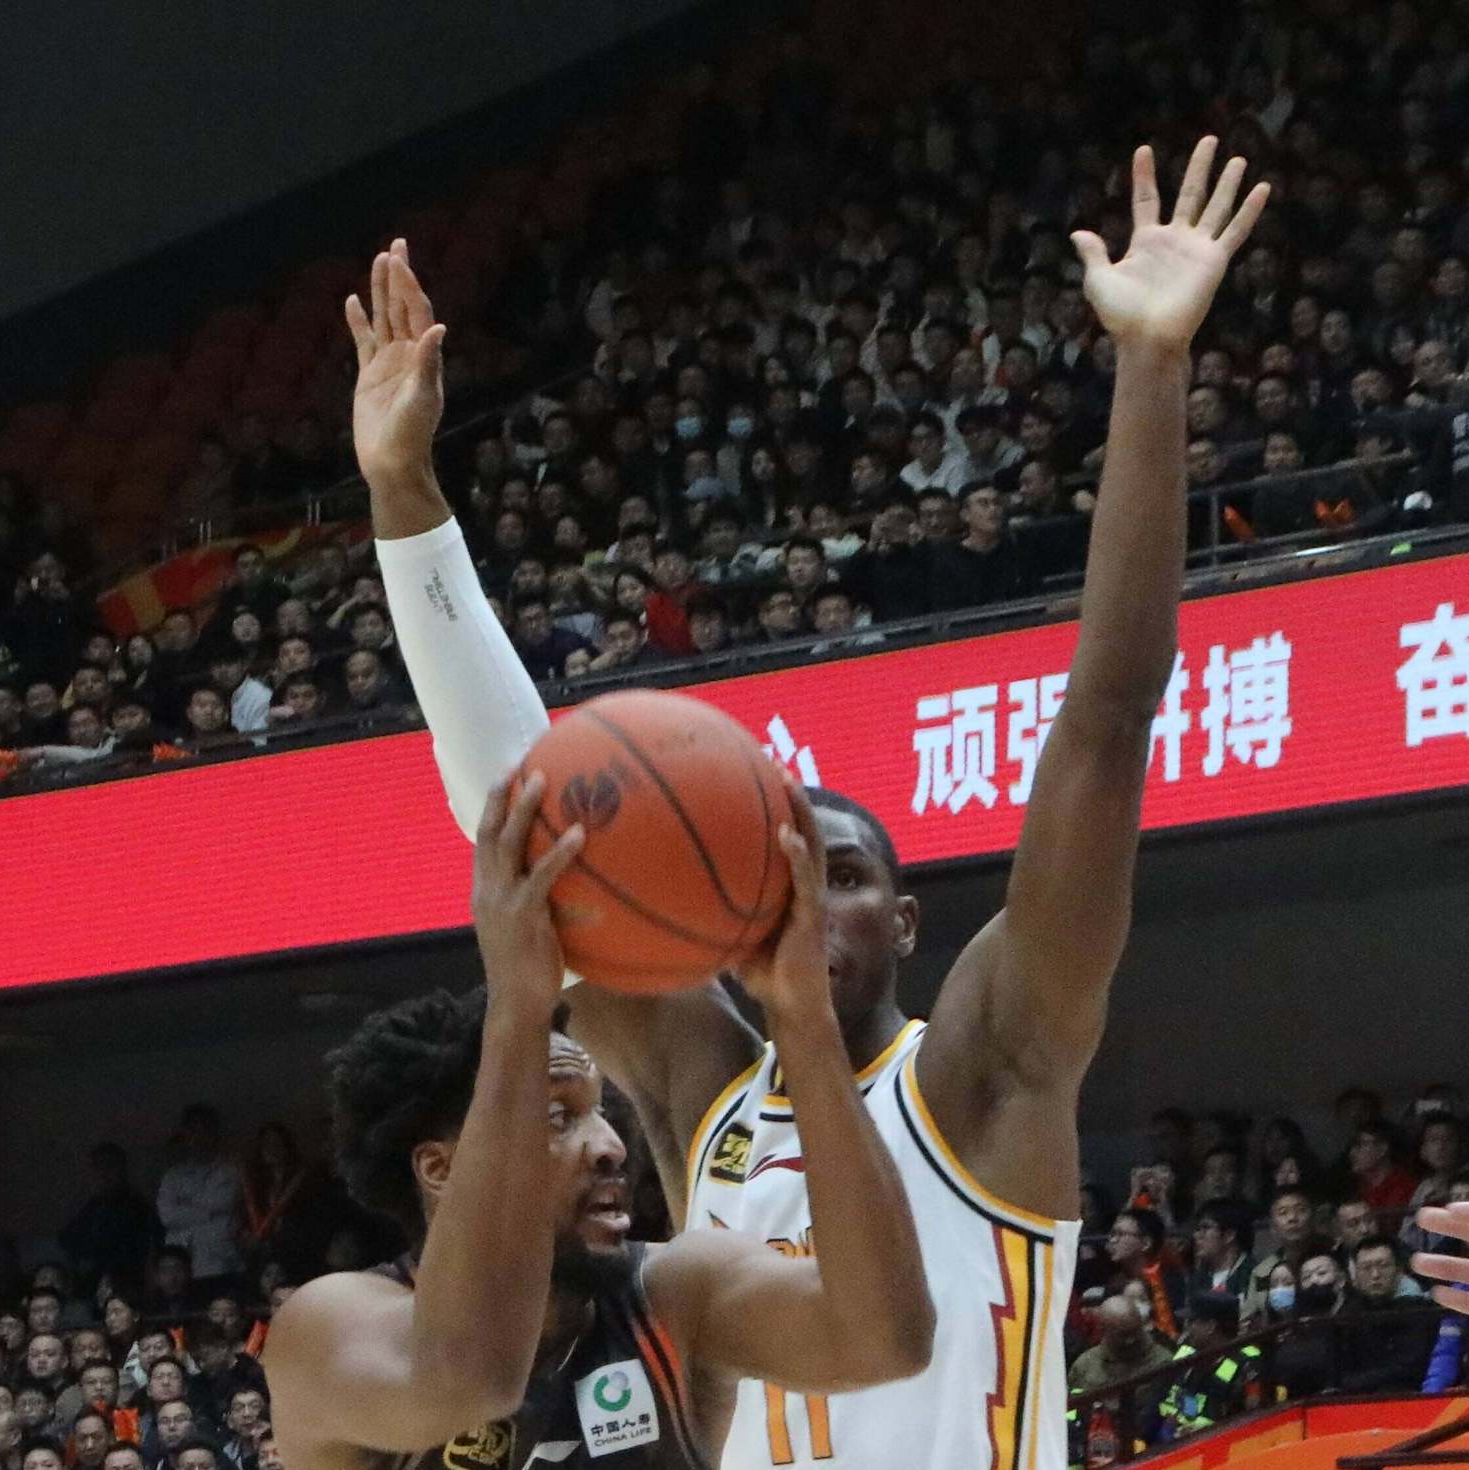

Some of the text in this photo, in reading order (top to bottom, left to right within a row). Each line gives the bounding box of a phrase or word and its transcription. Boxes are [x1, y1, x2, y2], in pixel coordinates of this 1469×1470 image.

[590, 1412, 652, 1438] 中国人寿
[593, 1432, 628, 1448] CHINA
